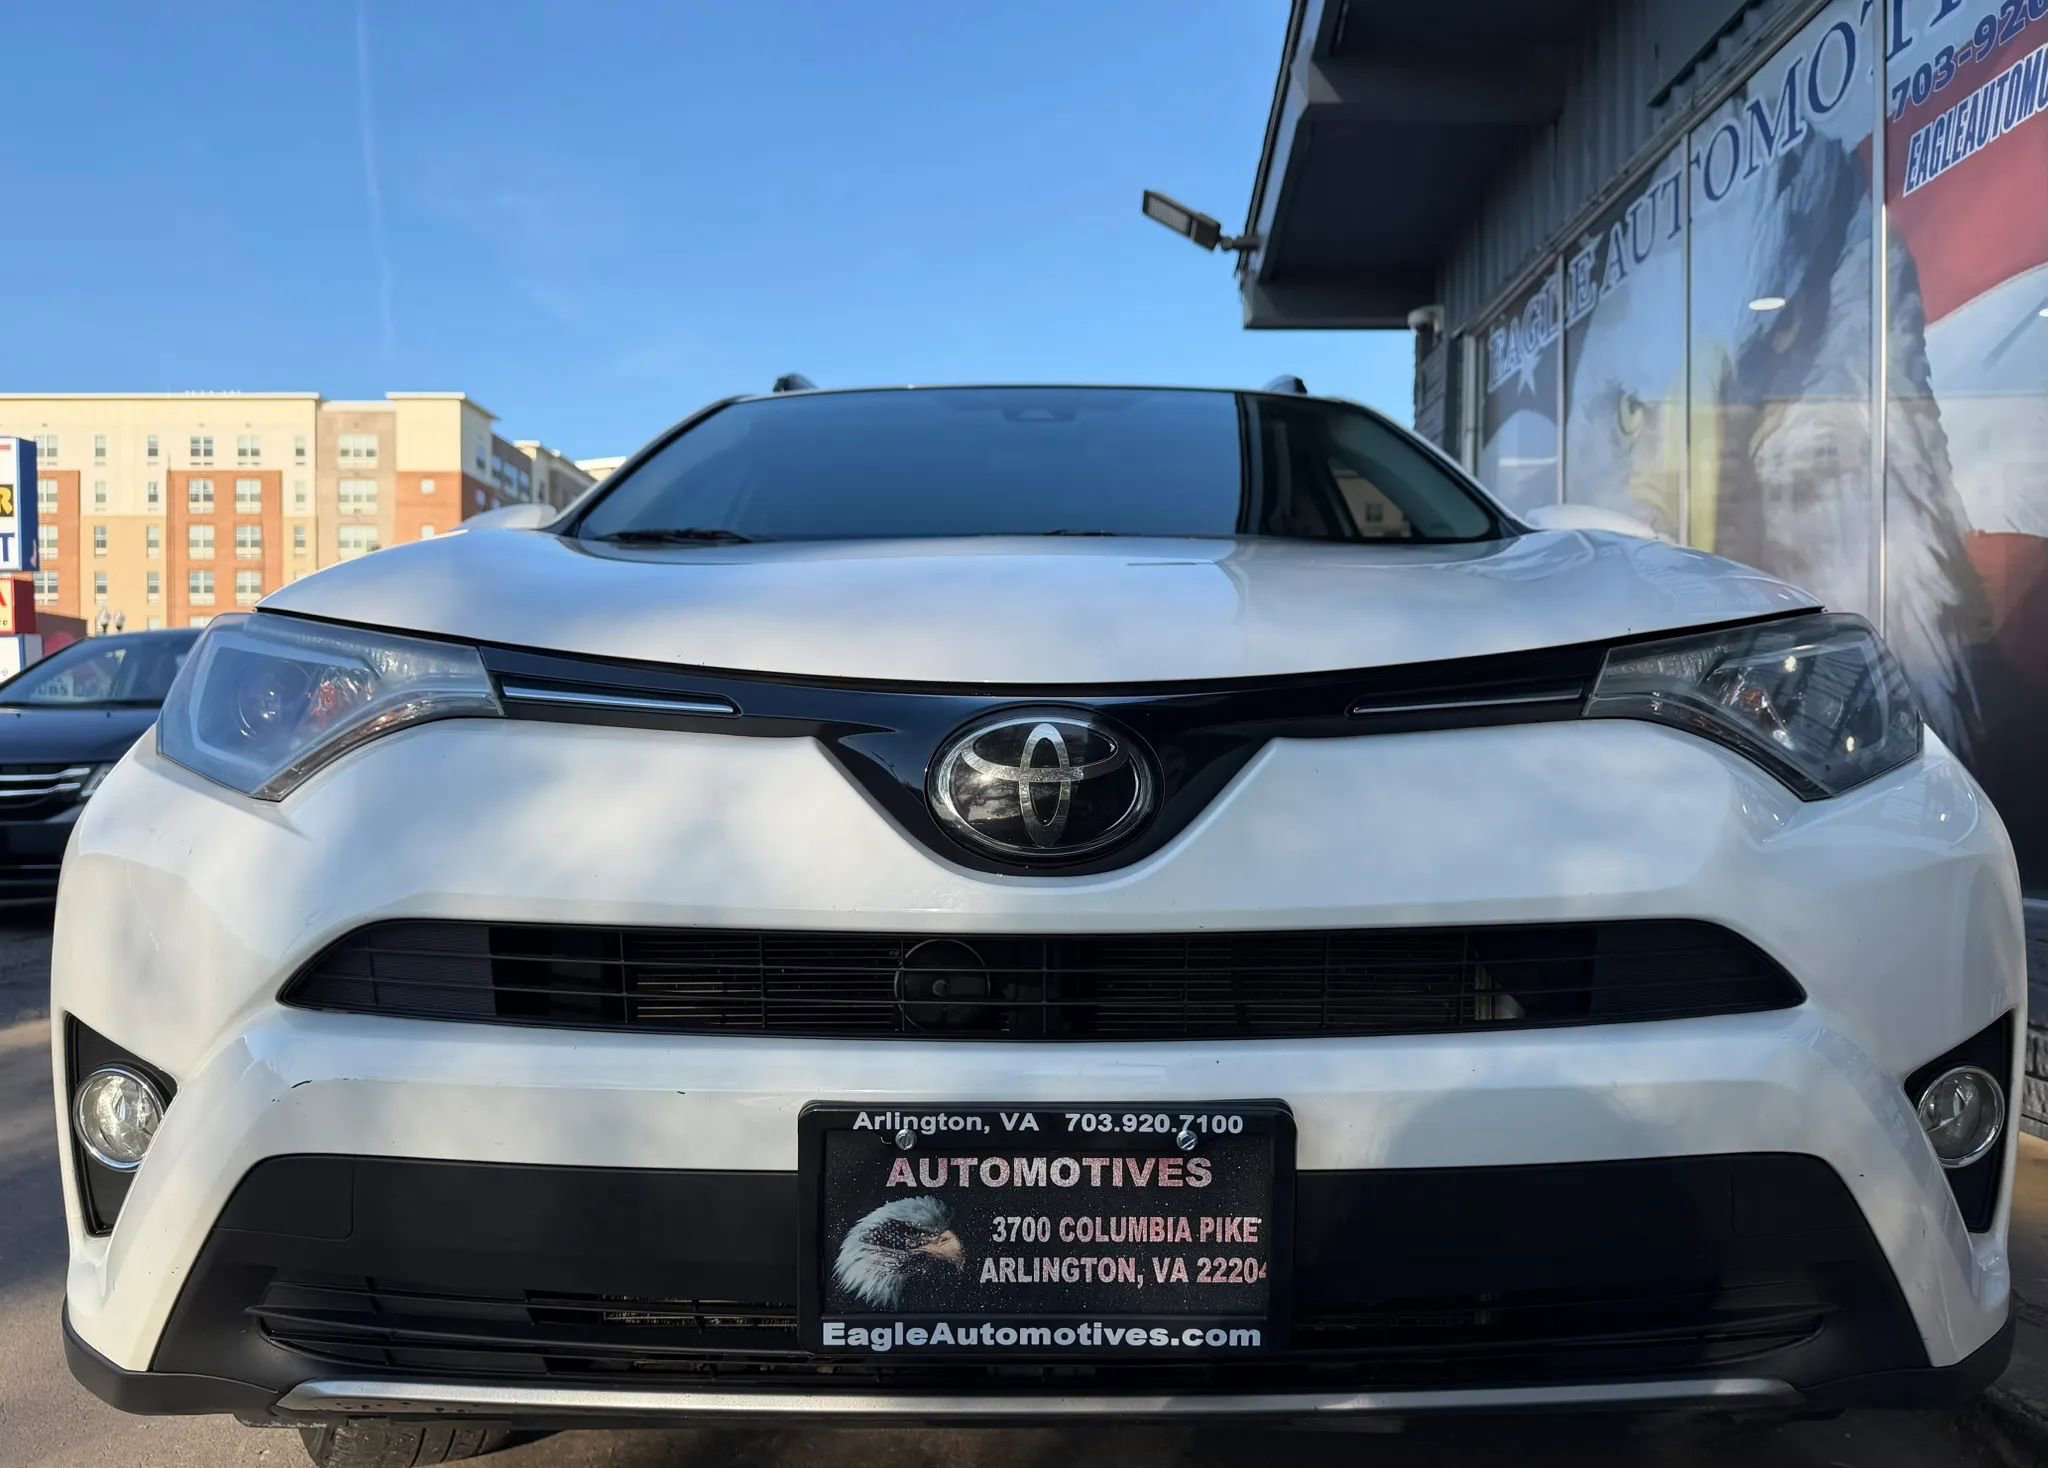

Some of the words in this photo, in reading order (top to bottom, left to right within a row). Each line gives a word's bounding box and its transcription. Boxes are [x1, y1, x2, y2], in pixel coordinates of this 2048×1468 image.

[853, 1111, 990, 1135] Arlington,
[1000, 1112, 1040, 1132] VA
[1065, 1113, 1244, 1134] 703.920.7100
[886, 1157, 1213, 1188] AUTOMOTIVES
[992, 1216, 1050, 1243] 3700
[1059, 1216, 1193, 1243] COLUMBIA
[1199, 1216, 1262, 1243] PIKE
[979, 1257, 1145, 1289] ARLINGTON,
[1152, 1257, 1190, 1283] VA
[822, 1322, 1262, 1351] EagleAutomotives.com
